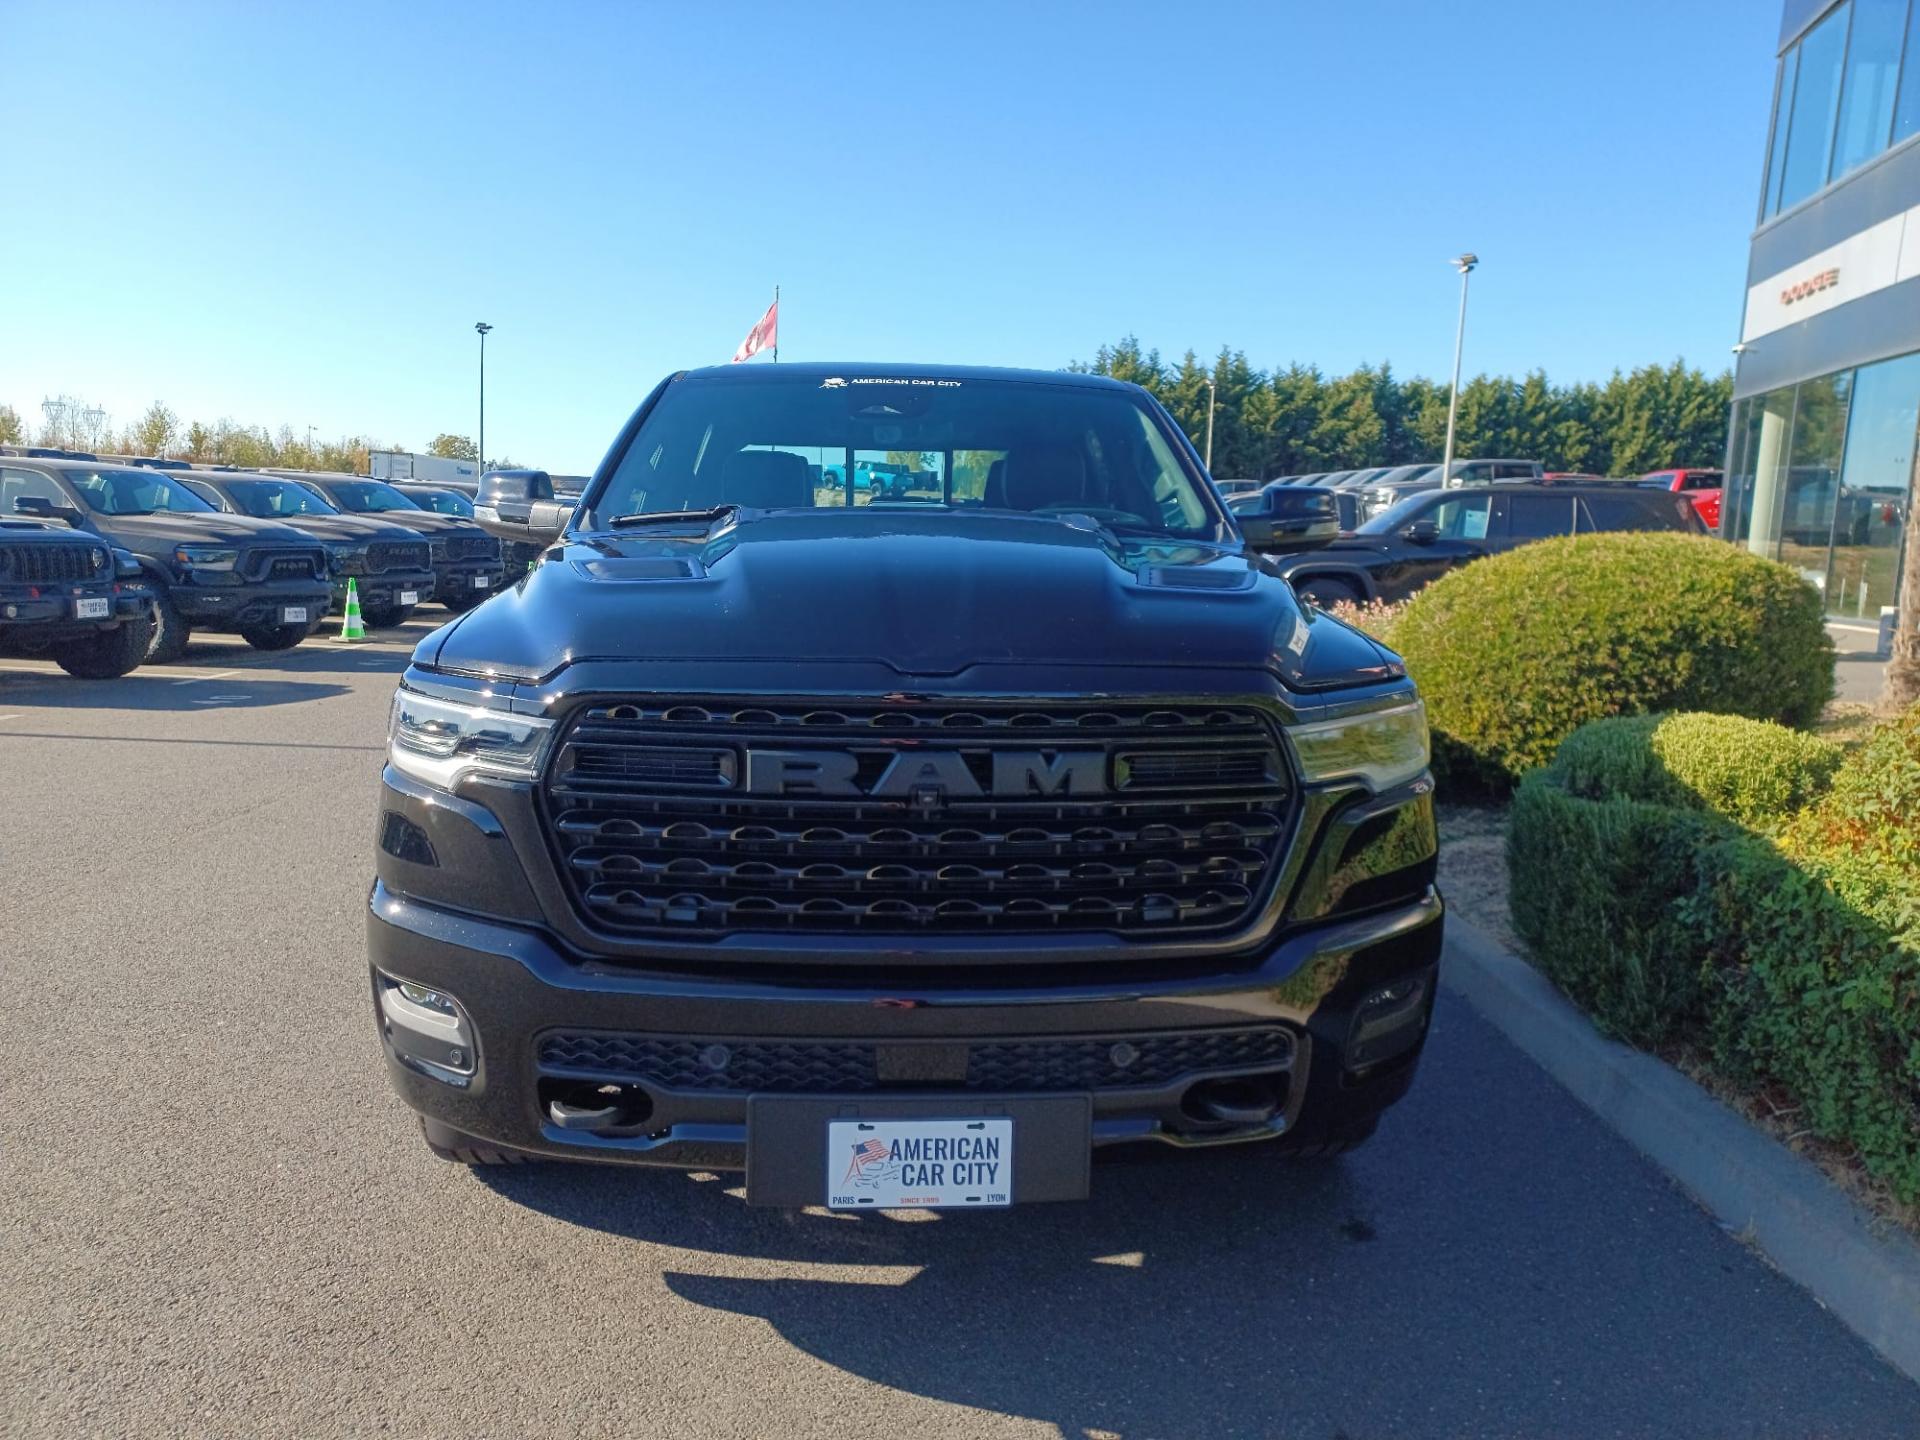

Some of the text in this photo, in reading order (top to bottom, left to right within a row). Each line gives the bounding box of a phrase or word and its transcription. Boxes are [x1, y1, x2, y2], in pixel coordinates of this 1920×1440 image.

[1779, 267, 1840, 305] DODGE
[746, 749, 1108, 796] RAM
[889, 1137, 1000, 1161] AMERICAN
[902, 1162, 999, 1186] CAR CITY
[832, 1196, 855, 1205] PARIS
[987, 1194, 1006, 1203] LYON
